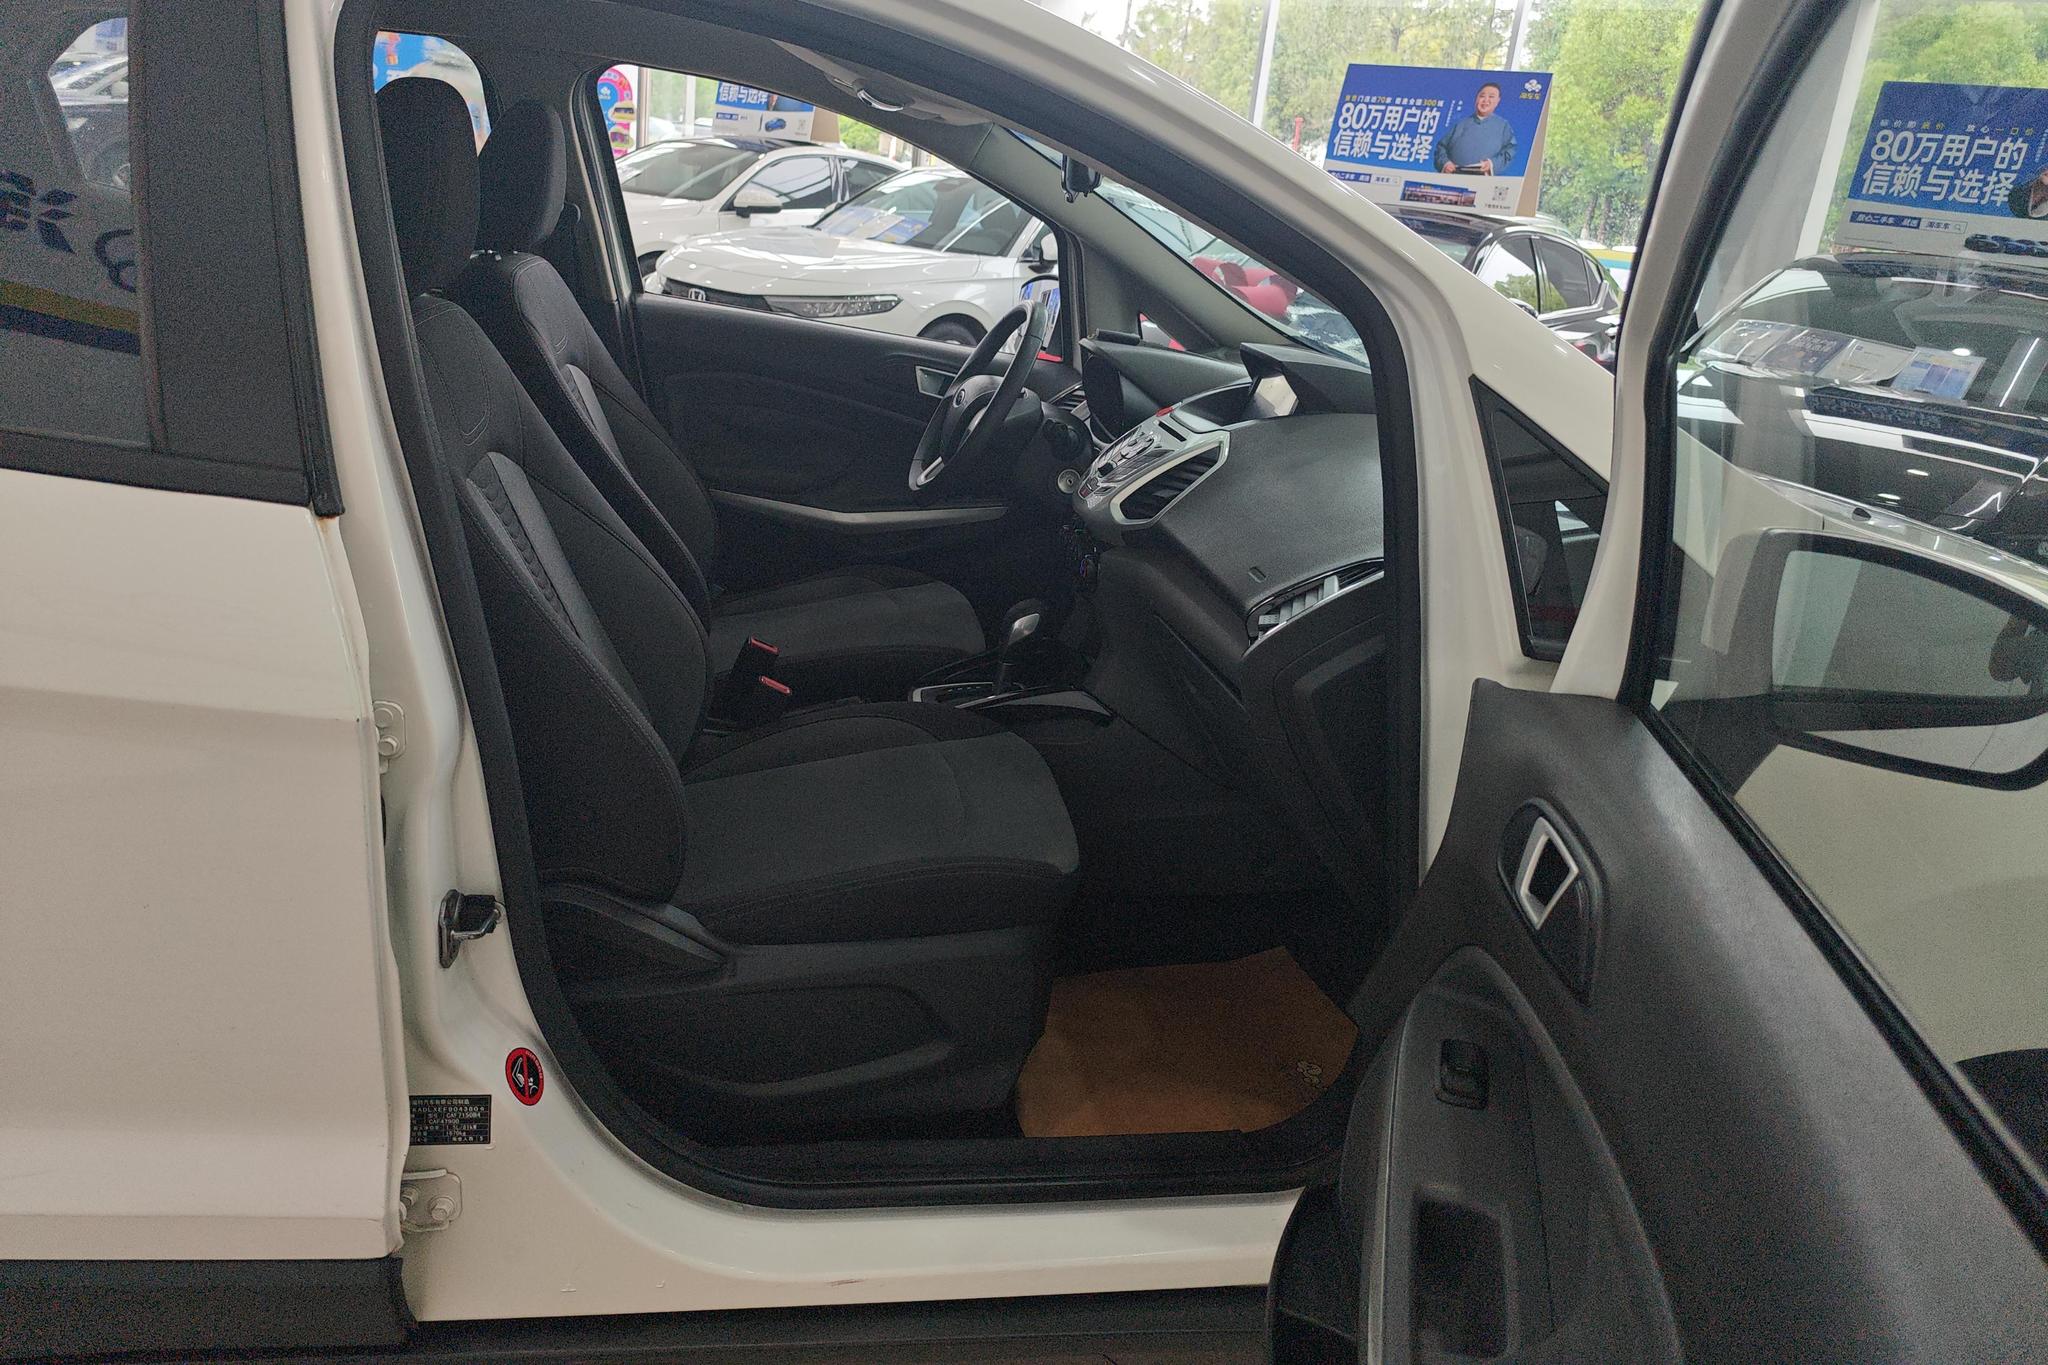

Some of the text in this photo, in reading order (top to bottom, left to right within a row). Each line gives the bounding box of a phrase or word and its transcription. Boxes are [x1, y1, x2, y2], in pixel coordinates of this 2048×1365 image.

[1338, 102, 1441, 134] 80万用户的
[1333, 129, 1434, 163] 信赖与选择
[1870, 129, 2029, 170] 80万用户的
[1861, 162, 2019, 207] 信赖与选择
